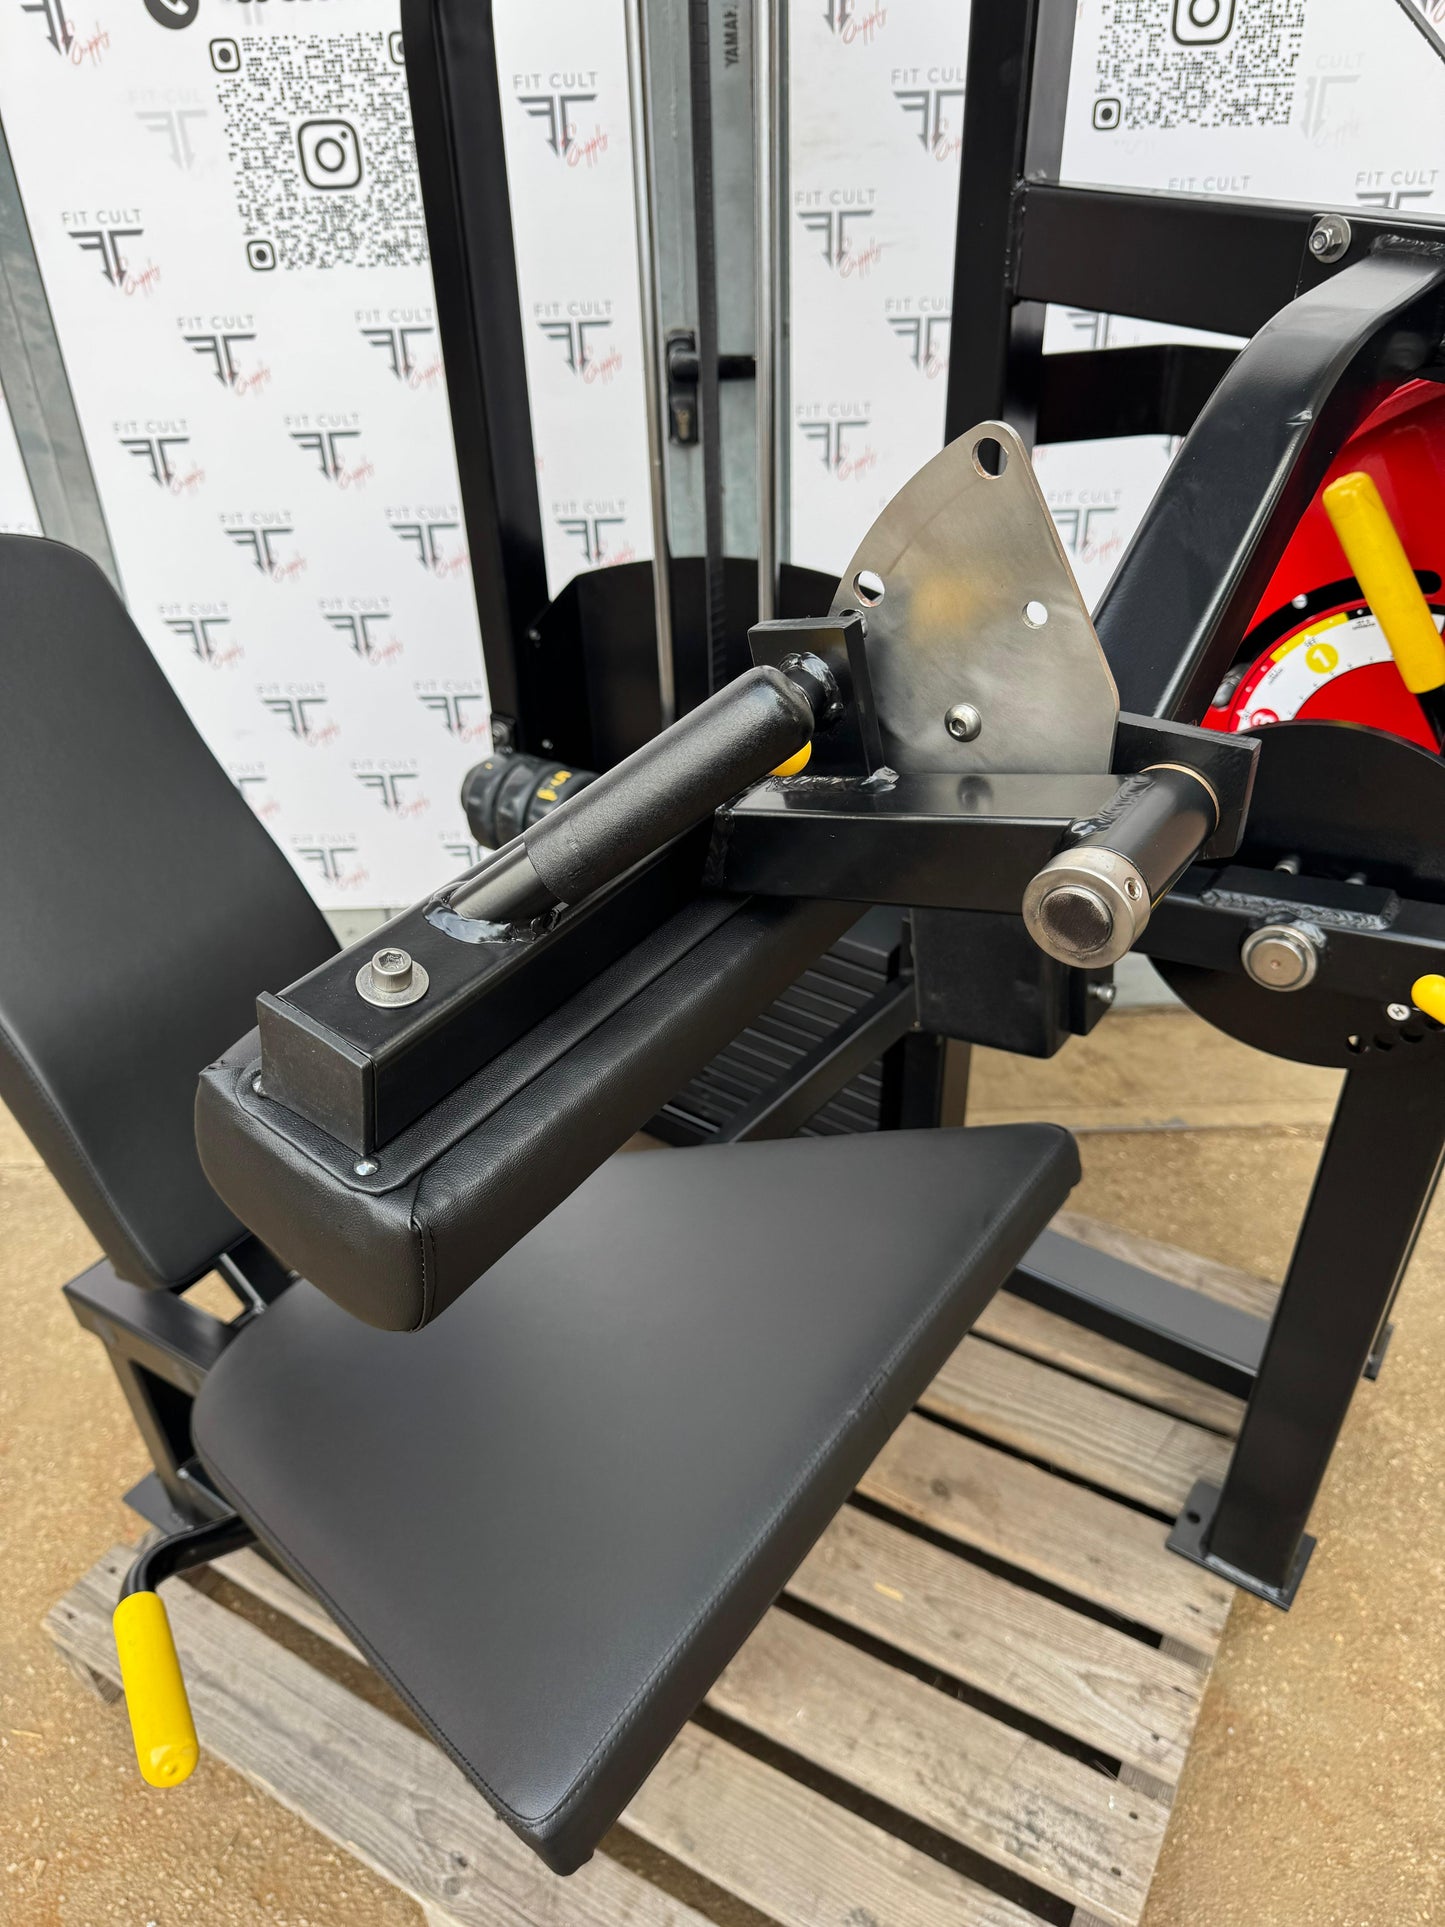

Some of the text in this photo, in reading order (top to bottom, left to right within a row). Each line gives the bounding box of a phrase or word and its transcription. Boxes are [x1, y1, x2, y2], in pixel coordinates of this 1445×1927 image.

[512, 71, 598, 90] FIT CULT
[891, 67, 964, 84] FIT CUL
[1168, 176, 1250, 192] FIT CULT
[1354, 169, 1440, 187] FIT CULT
[794, 188, 876, 206] FIT CULT
[61, 208, 142, 225] FIT CULT
[533, 300, 613, 317] FIT CULT
[885, 298, 912, 313] FIT
[176, 314, 255, 329] FIT CULT
[354, 307, 434, 323] FIT CULT
[795, 401, 871, 417] FIT CULT
